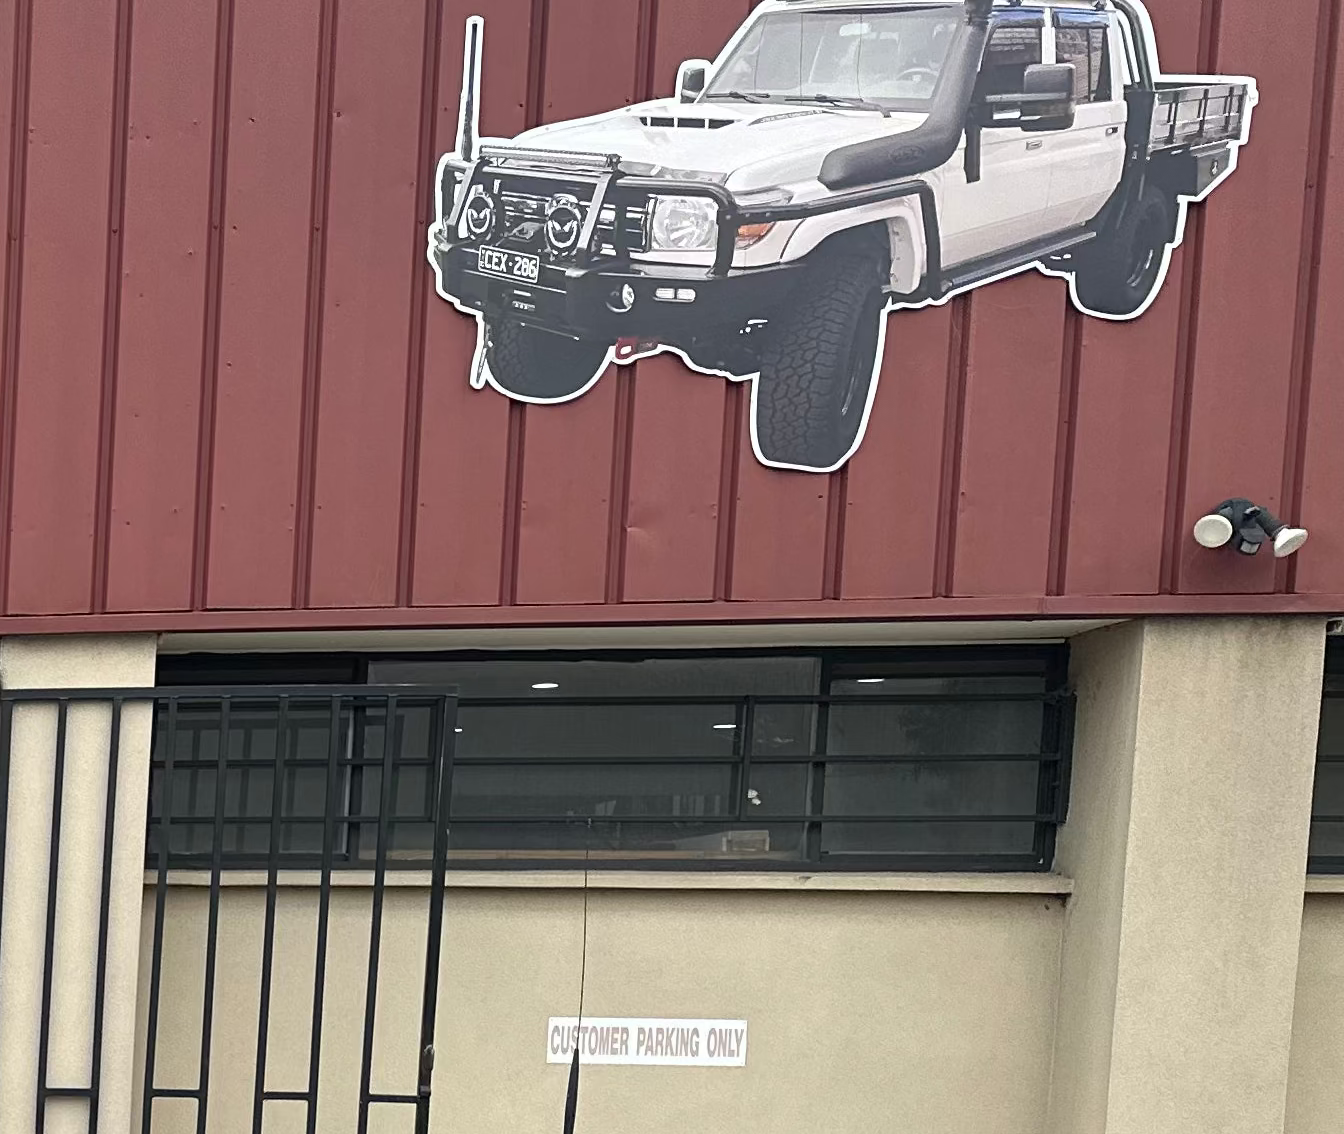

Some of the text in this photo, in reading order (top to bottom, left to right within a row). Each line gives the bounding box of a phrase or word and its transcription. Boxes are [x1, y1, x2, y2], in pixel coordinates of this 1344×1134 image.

[550, 1025, 745, 1058] CUSTOMER PARKING ONLY
